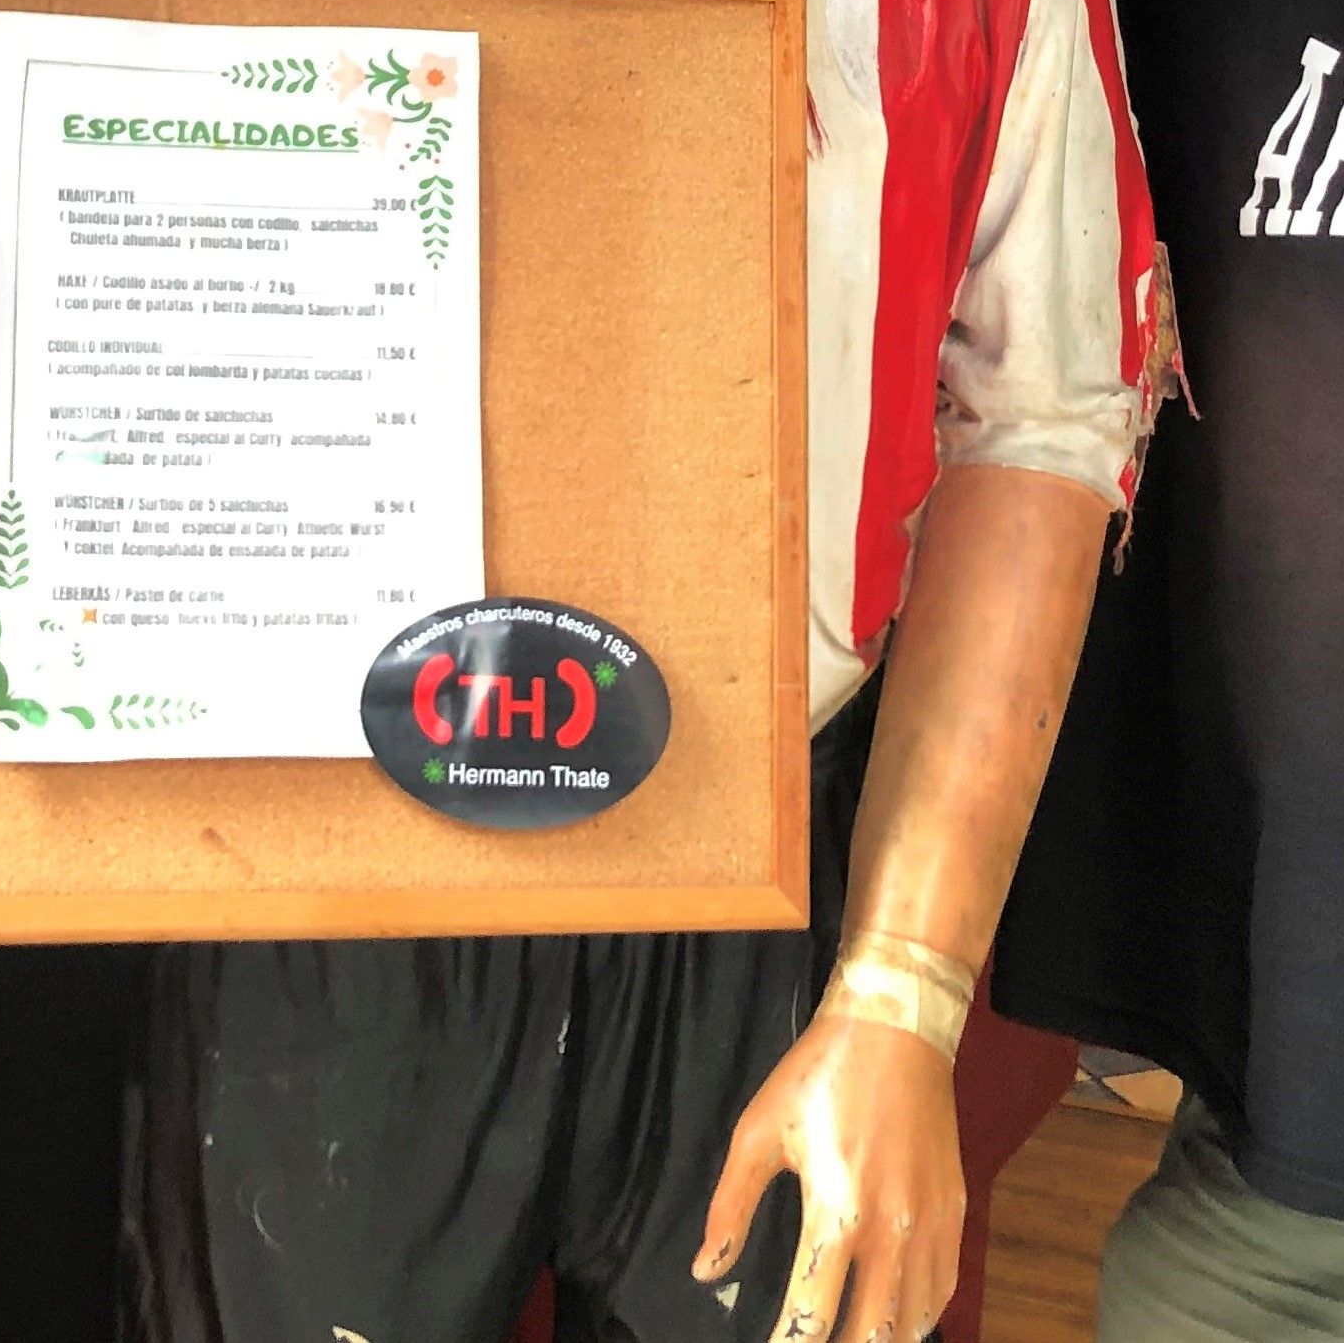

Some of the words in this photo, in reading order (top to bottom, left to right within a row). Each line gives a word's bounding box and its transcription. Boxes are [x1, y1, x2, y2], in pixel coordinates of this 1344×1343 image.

[63, 114, 359, 148] ESPECIALIDADES
[58, 188, 136, 205] KRAUTPLATTE
[68, 210, 120, 226] bandeja
[124, 214, 153, 228] para
[168, 215, 227, 230] personas
[231, 216, 254, 230] con
[310, 219, 379, 232] salchichas
[70, 231, 119, 246] Chuleta
[123, 233, 181, 248] ahumada
[200, 236, 243, 250] mucha
[247, 237, 281, 251] berza
[103, 275, 146, 290] Codillo
[150, 276, 189, 291] asado
[64, 297, 89, 310] con
[126, 297, 142, 311] de
[146, 299, 194, 313] patatas
[47, 339, 96, 354] CODILLO
[100, 340, 163, 354] INDIVIDUAL
[188, 363, 248, 379] lombarda
[396, 615, 464, 659] Maestros
[465, 606, 553, 626] charcuteros
[555, 613, 602, 642] desde
[602, 633, 639, 668] 1932
[447, 762, 546, 787] Hermann
[549, 764, 612, 790] Thate
